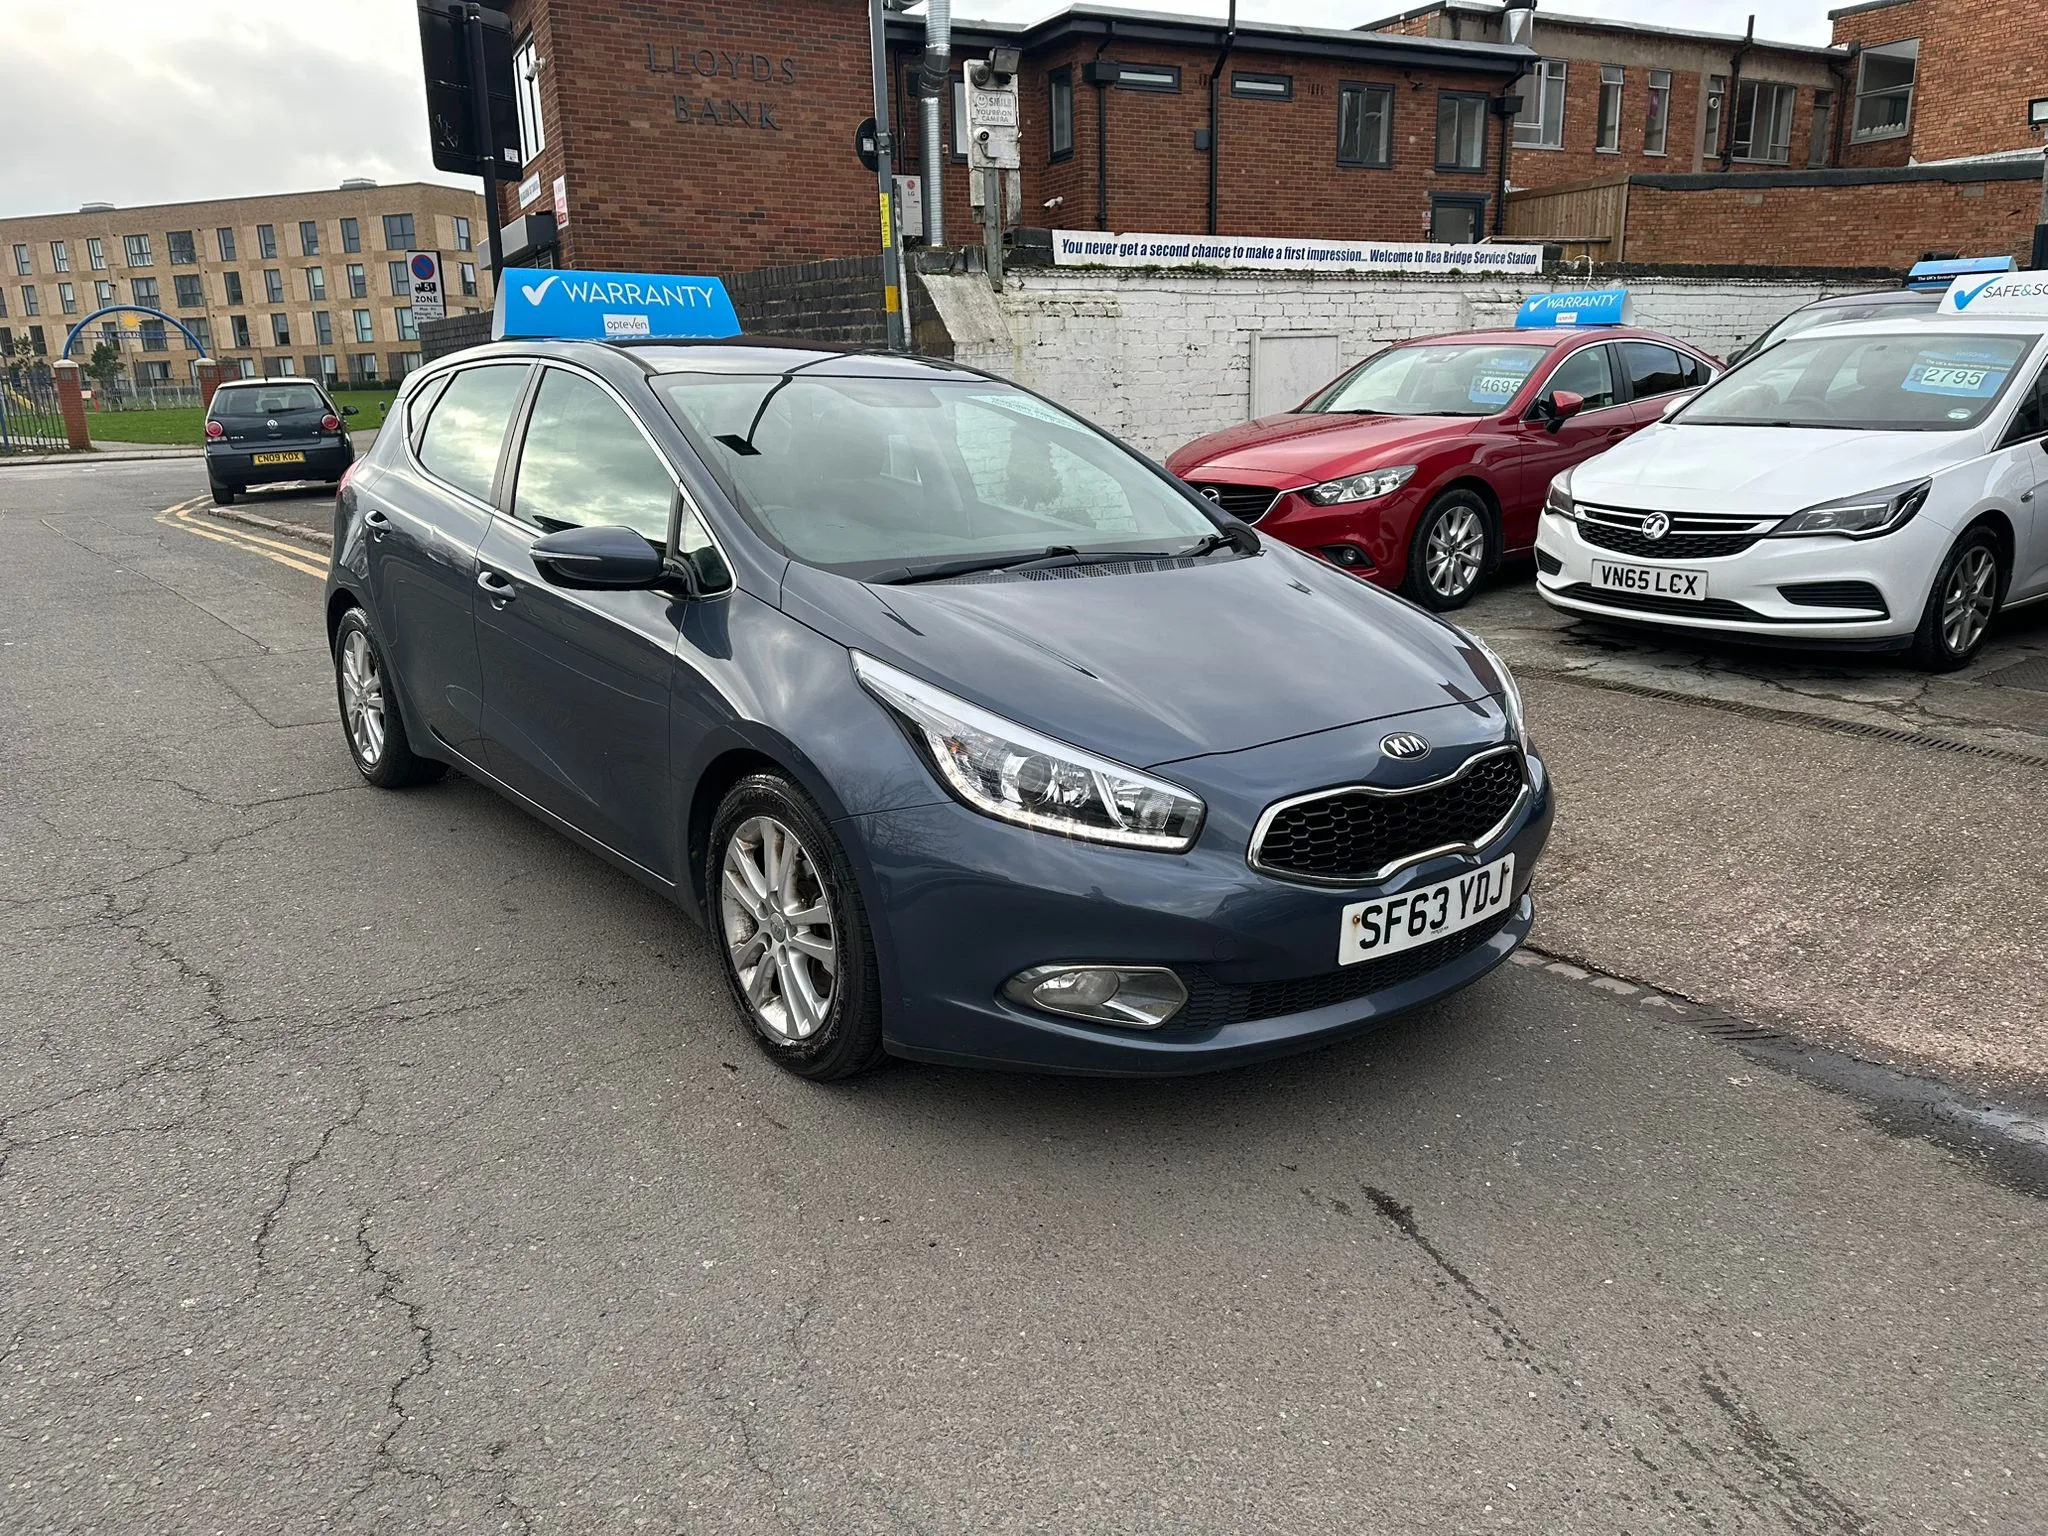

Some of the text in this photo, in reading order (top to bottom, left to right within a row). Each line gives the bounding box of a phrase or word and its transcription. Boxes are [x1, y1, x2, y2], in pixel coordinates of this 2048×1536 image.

[646, 43, 795, 85] LLOYDS
[673, 94, 783, 131] BANK
[989, 97, 1012, 107] SMILE
[1062, 238, 1083, 254] You
[1085, 241, 1118, 255] never
[1120, 242, 1139, 257] get
[1140, 244, 1147, 256] a
[1150, 243, 1190, 257] second
[1192, 244, 1230, 258] chance
[1233, 246, 1244, 259] to
[1246, 245, 1274, 259] make
[1276, 248, 1283, 259] a
[1284, 246, 1305, 260] first
[1370, 249, 1413, 262] Welcome
[1415, 251, 1424, 263] to
[1425, 251, 1442, 263] Rea
[1443, 251, 1472, 265] Bridge
[1474, 251, 1506, 264] Service
[1507, 252, 1537, 265] Station
[415, 295, 439, 303] ZONE
[561, 280, 714, 308] WARRANTY
[1546, 294, 1618, 308] WARRANTY
[606, 316, 648, 331] opteven
[257, 452, 300, 463] CN09 KOX
[1602, 565, 1698, 595] VN65 LCX
[1386, 735, 1426, 755] KIA
[1359, 862, 1506, 949] SF63 YDJ
